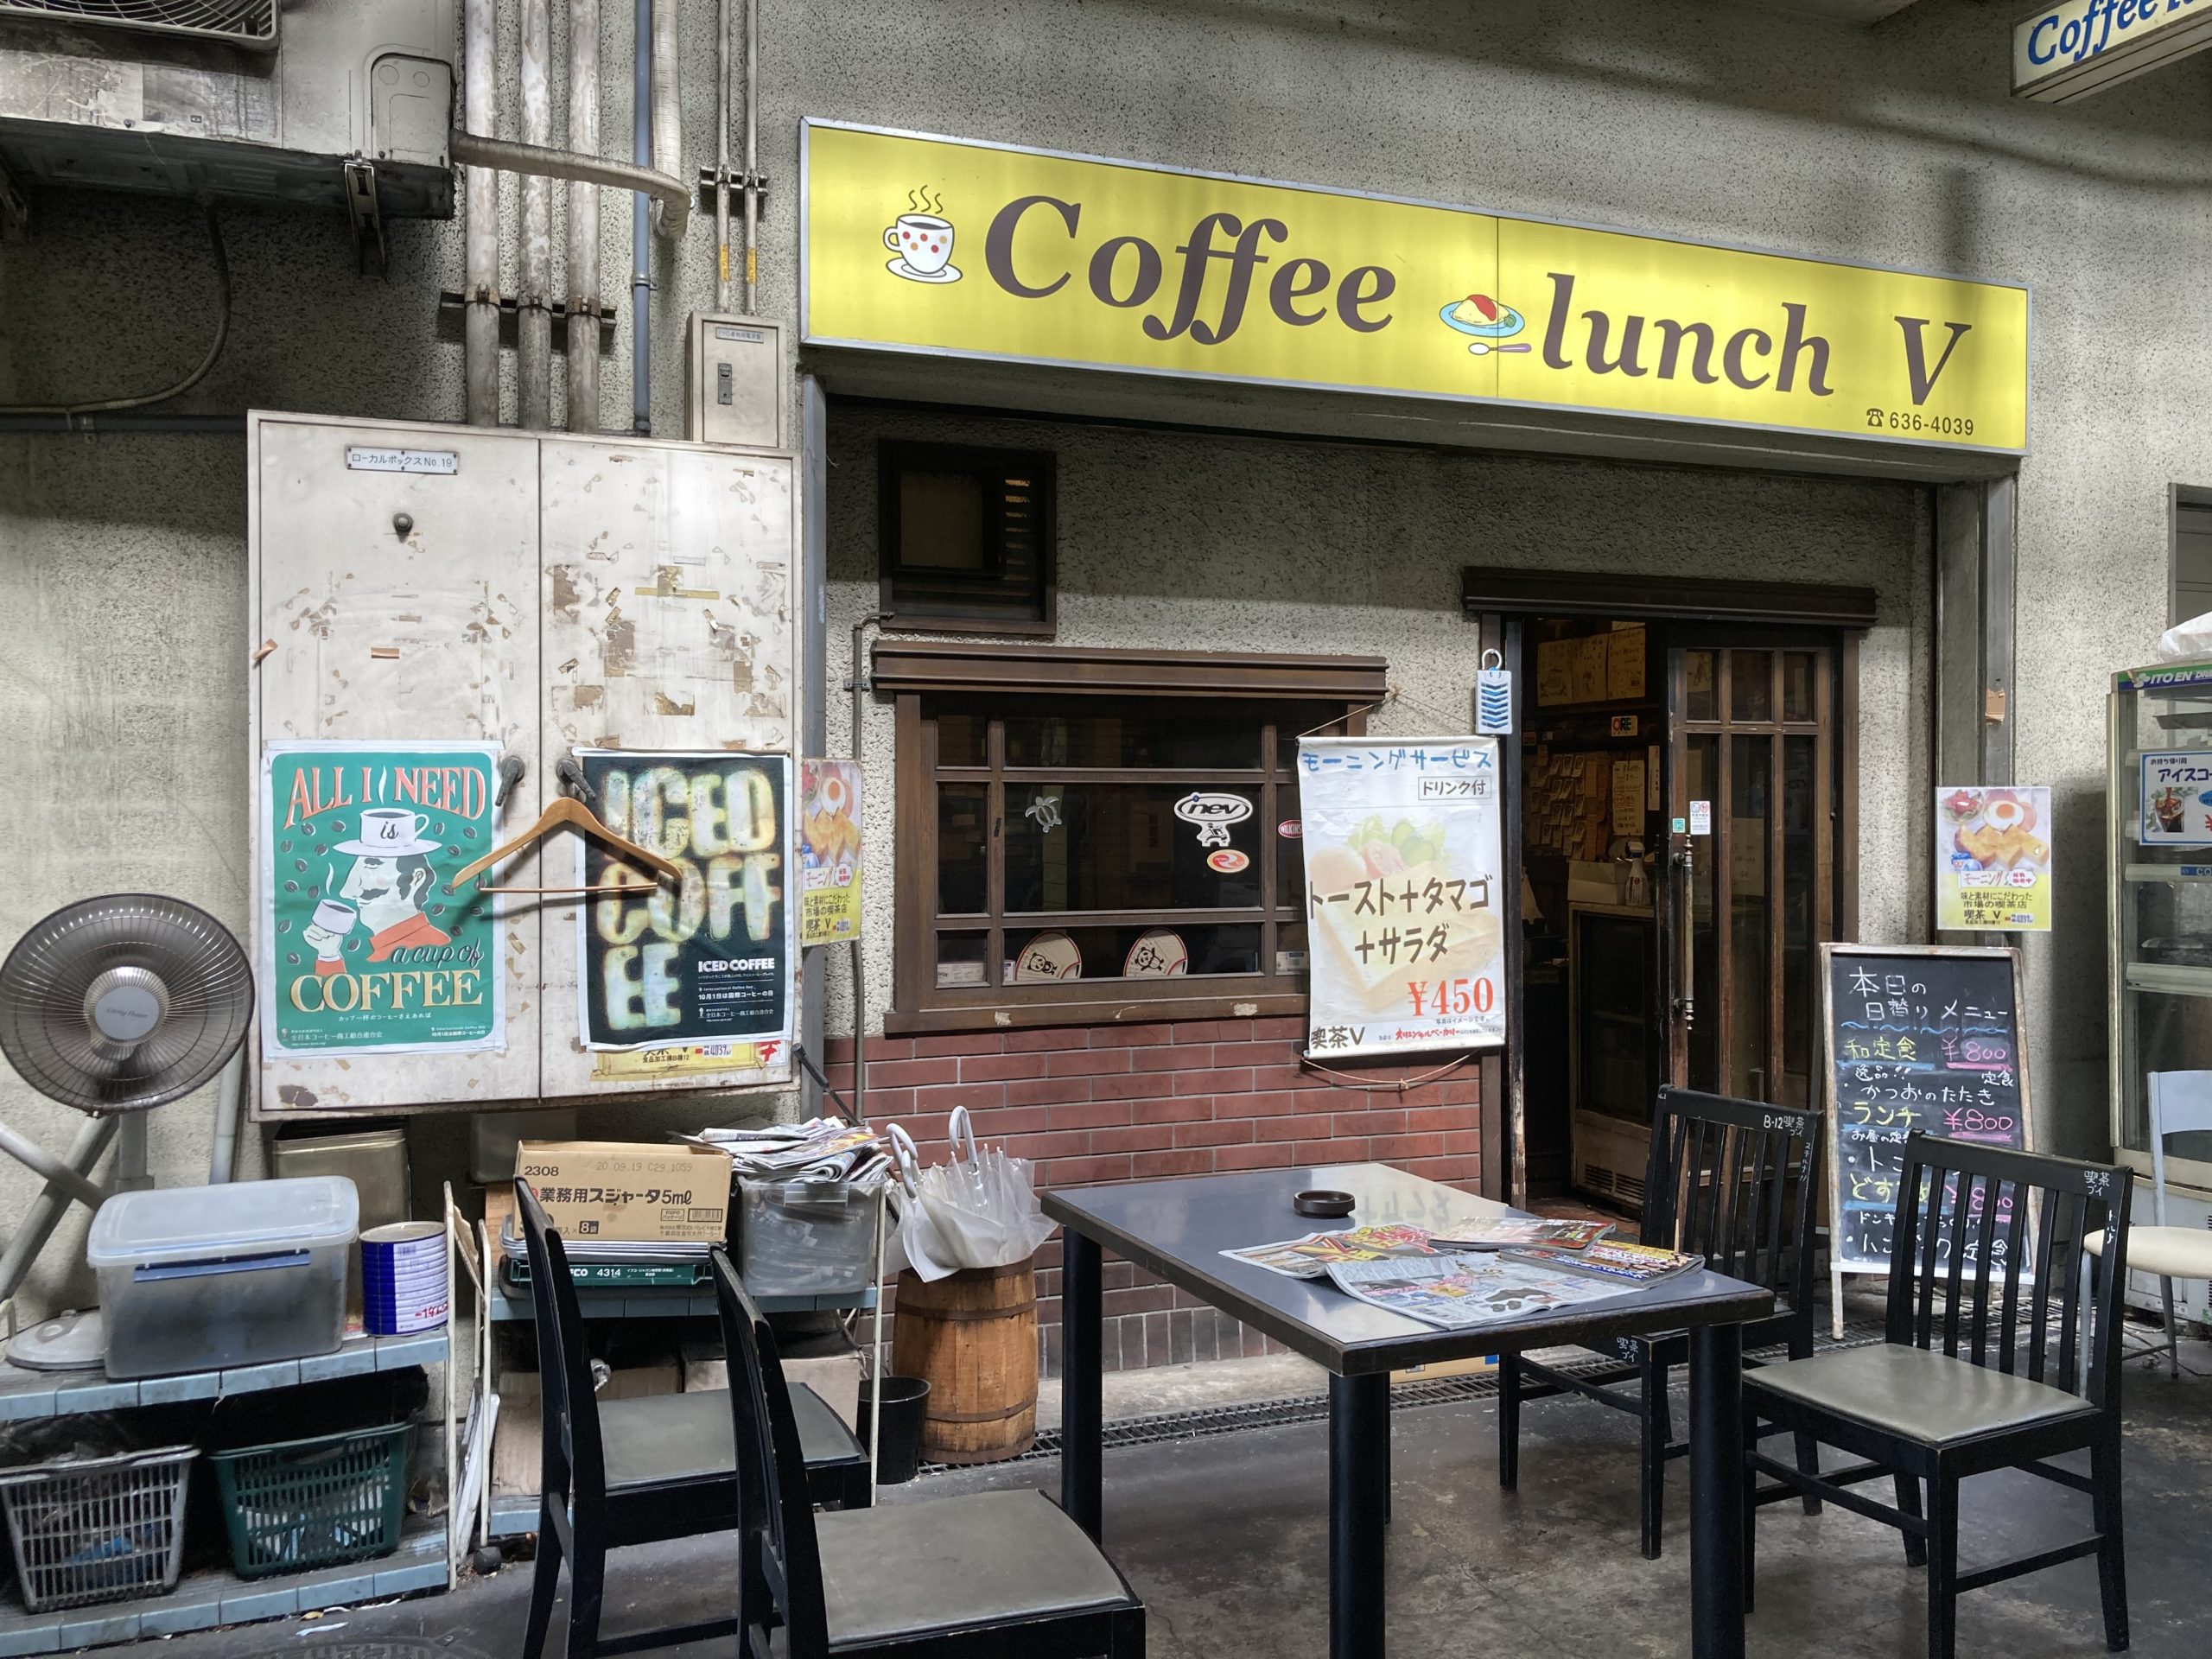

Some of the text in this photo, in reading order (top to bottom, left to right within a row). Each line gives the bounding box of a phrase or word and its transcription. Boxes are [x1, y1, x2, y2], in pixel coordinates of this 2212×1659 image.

[984, 194, 1972, 405] Coffee lunch V
[1890, 411, 1974, 435] 636-4039
[2150, 674, 2174, 684] ITO
[2174, 671, 2193, 682] EN
[1302, 748, 1492, 772] モーニングサービス
[283, 766, 486, 830] ALL I NEED
[1422, 779, 1487, 798] ドリンク付
[603, 767, 776, 859] ICED
[380, 821, 399, 840] is
[1963, 900, 2027, 909] 市場の喫茶店
[412, 945, 454, 969] cup
[457, 938, 484, 969] of
[698, 957, 775, 973] ICED COFFEE
[290, 969, 483, 1013] COFFEE
[1848, 966, 1926, 998] 本日の
[698, 989, 773, 1001] 10月1日は国際コーヒーの日
[1408, 977, 1494, 1017] ¥450
[1846, 1036, 2007, 1062] 和定食 ¥800
[1981, 1071, 2013, 1087] 定食
[1860, 1082, 1995, 1106] かつおのたたき
[1853, 1102, 2013, 1131] ランチ ¥800
[524, 1166, 559, 1177] 2308
[2084, 1170, 2110, 1187] 喫茶
[597, 1268, 621, 1278] 4314
